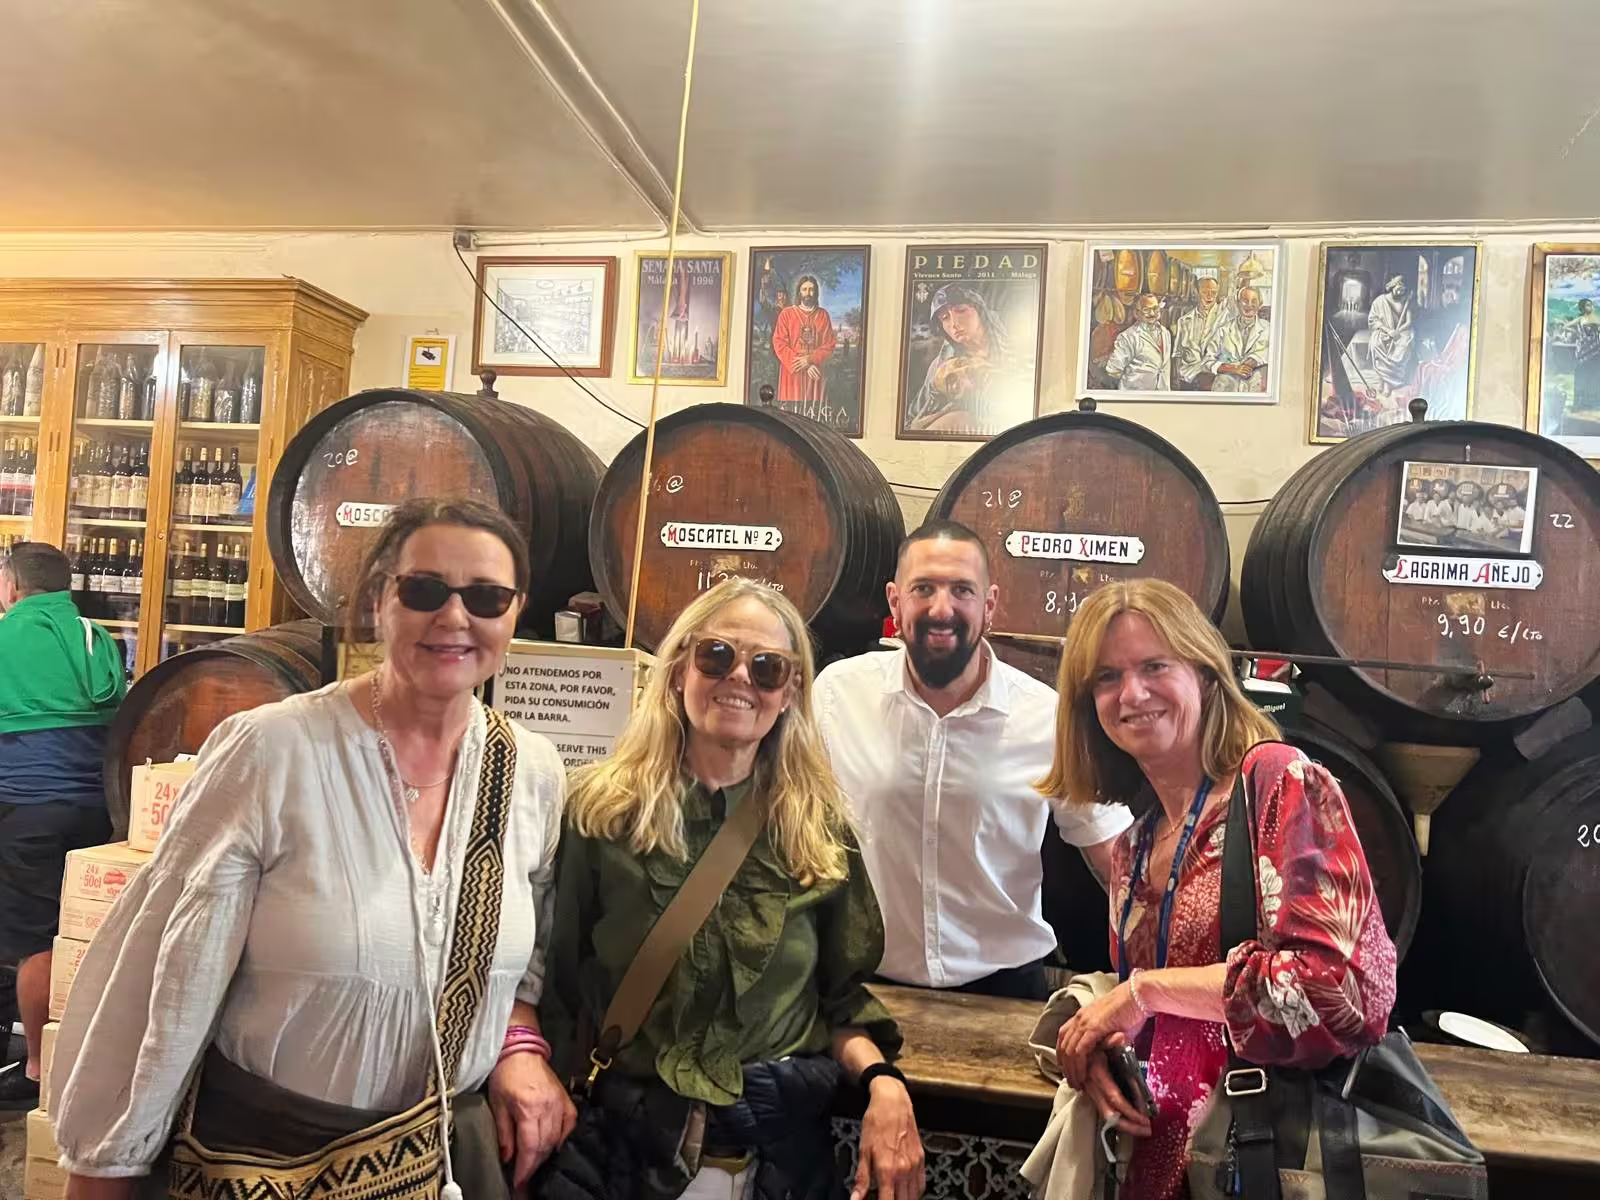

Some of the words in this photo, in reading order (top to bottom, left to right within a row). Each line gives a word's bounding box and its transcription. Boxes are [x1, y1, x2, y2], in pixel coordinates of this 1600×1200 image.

[642, 259, 683, 273] SEMAA
[687, 260, 720, 273] SANTA
[913, 254, 1038, 269] PIEDAD
[647, 275, 678, 285] Málaa
[692, 276, 714, 285] 1996
[1550, 513, 1575, 528] 22
[667, 524, 739, 545] MOSCATEL
[765, 531, 773, 546] 2
[1020, 534, 1072, 554] PEDRO
[1079, 537, 1129, 558] XIMEN
[1393, 559, 1469, 581] LAGRIMA
[1472, 561, 1531, 584] AÑEJO
[1437, 613, 1485, 639] 9,90
[506, 666, 520, 675] NO
[522, 668, 580, 678] ATENDEMOS
[582, 670, 602, 680] POR
[505, 681, 527, 690] ESTA
[530, 683, 558, 693] ZONA,
[560, 684, 579, 693] POR
[581, 685, 616, 696] FAVOR,
[504, 696, 526, 705] PIDA
[528, 697, 540, 706] SU
[542, 697, 610, 710] CONSUMICIÓN
[504, 710, 522, 719] POR
[525, 712, 536, 720] LA
[538, 712, 571, 722] BARRA.
[556, 743, 584, 753] SERVE
[586, 745, 607, 755] THIS
